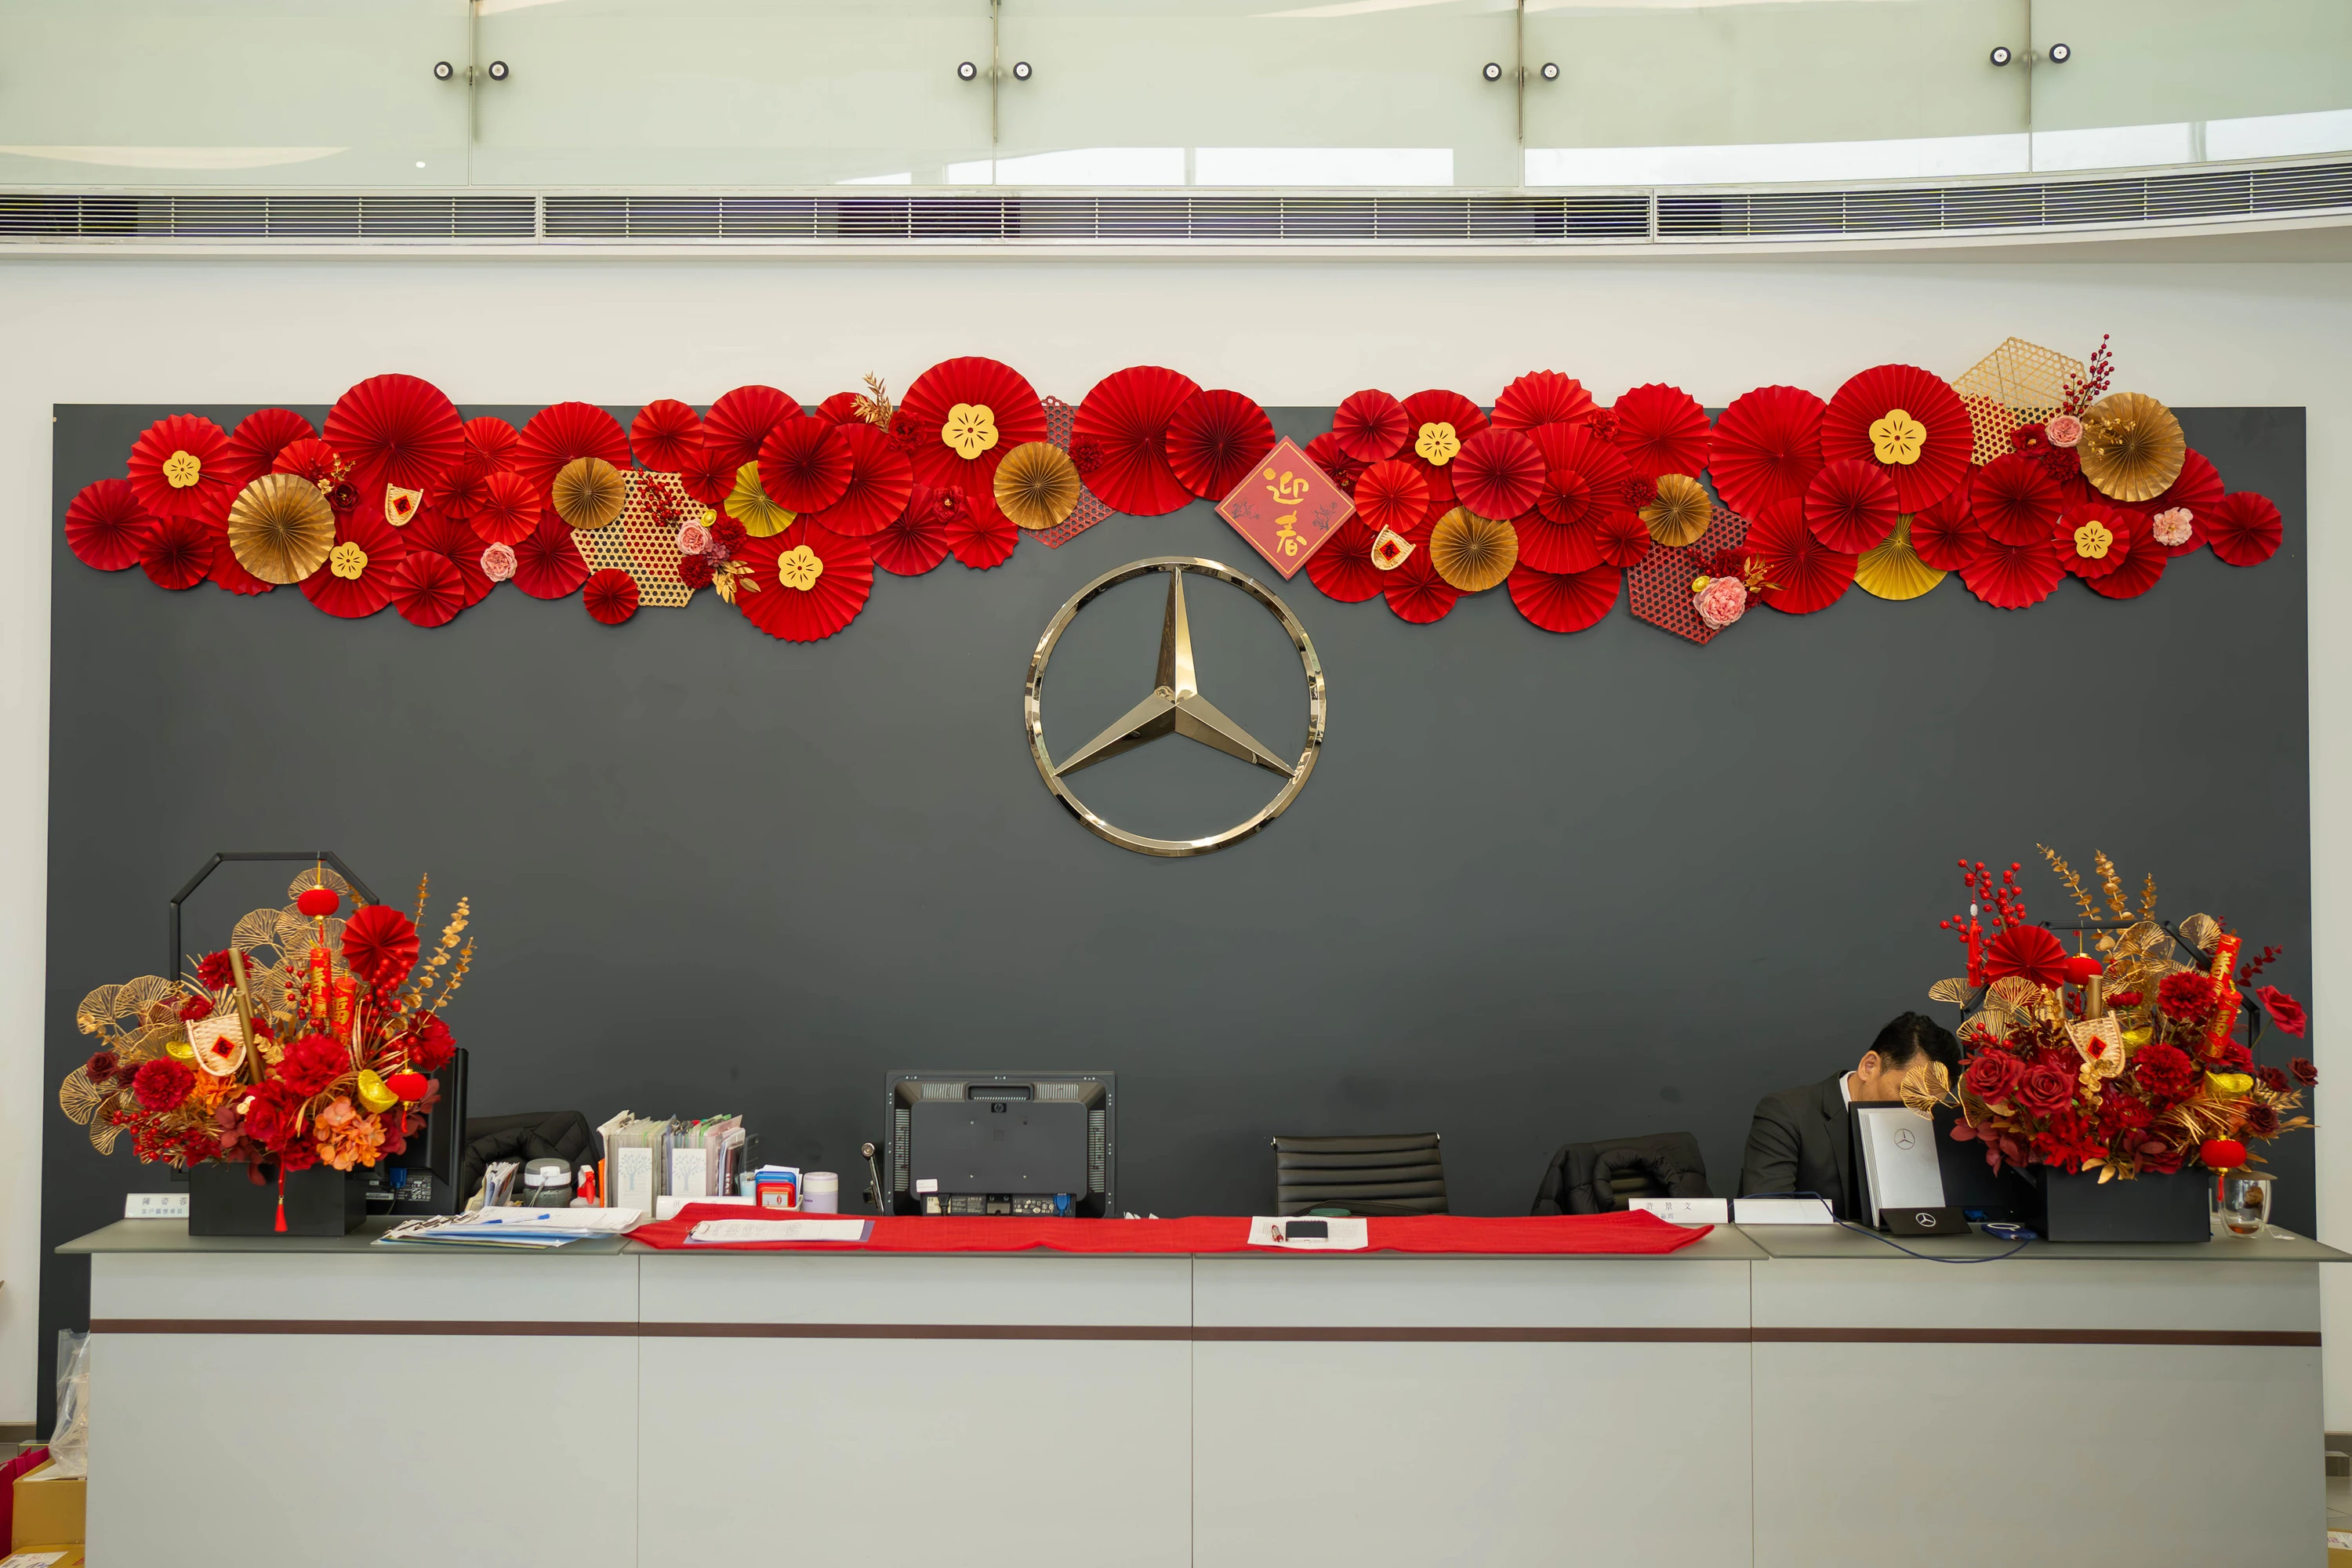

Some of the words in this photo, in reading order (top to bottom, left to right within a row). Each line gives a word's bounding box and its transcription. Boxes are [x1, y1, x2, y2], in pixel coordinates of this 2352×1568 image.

[1263, 467, 1309, 557] 迎春
[1384, 544, 1396, 557] 春
[311, 966, 326, 995] 春
[2210, 950, 2233, 981] 春
